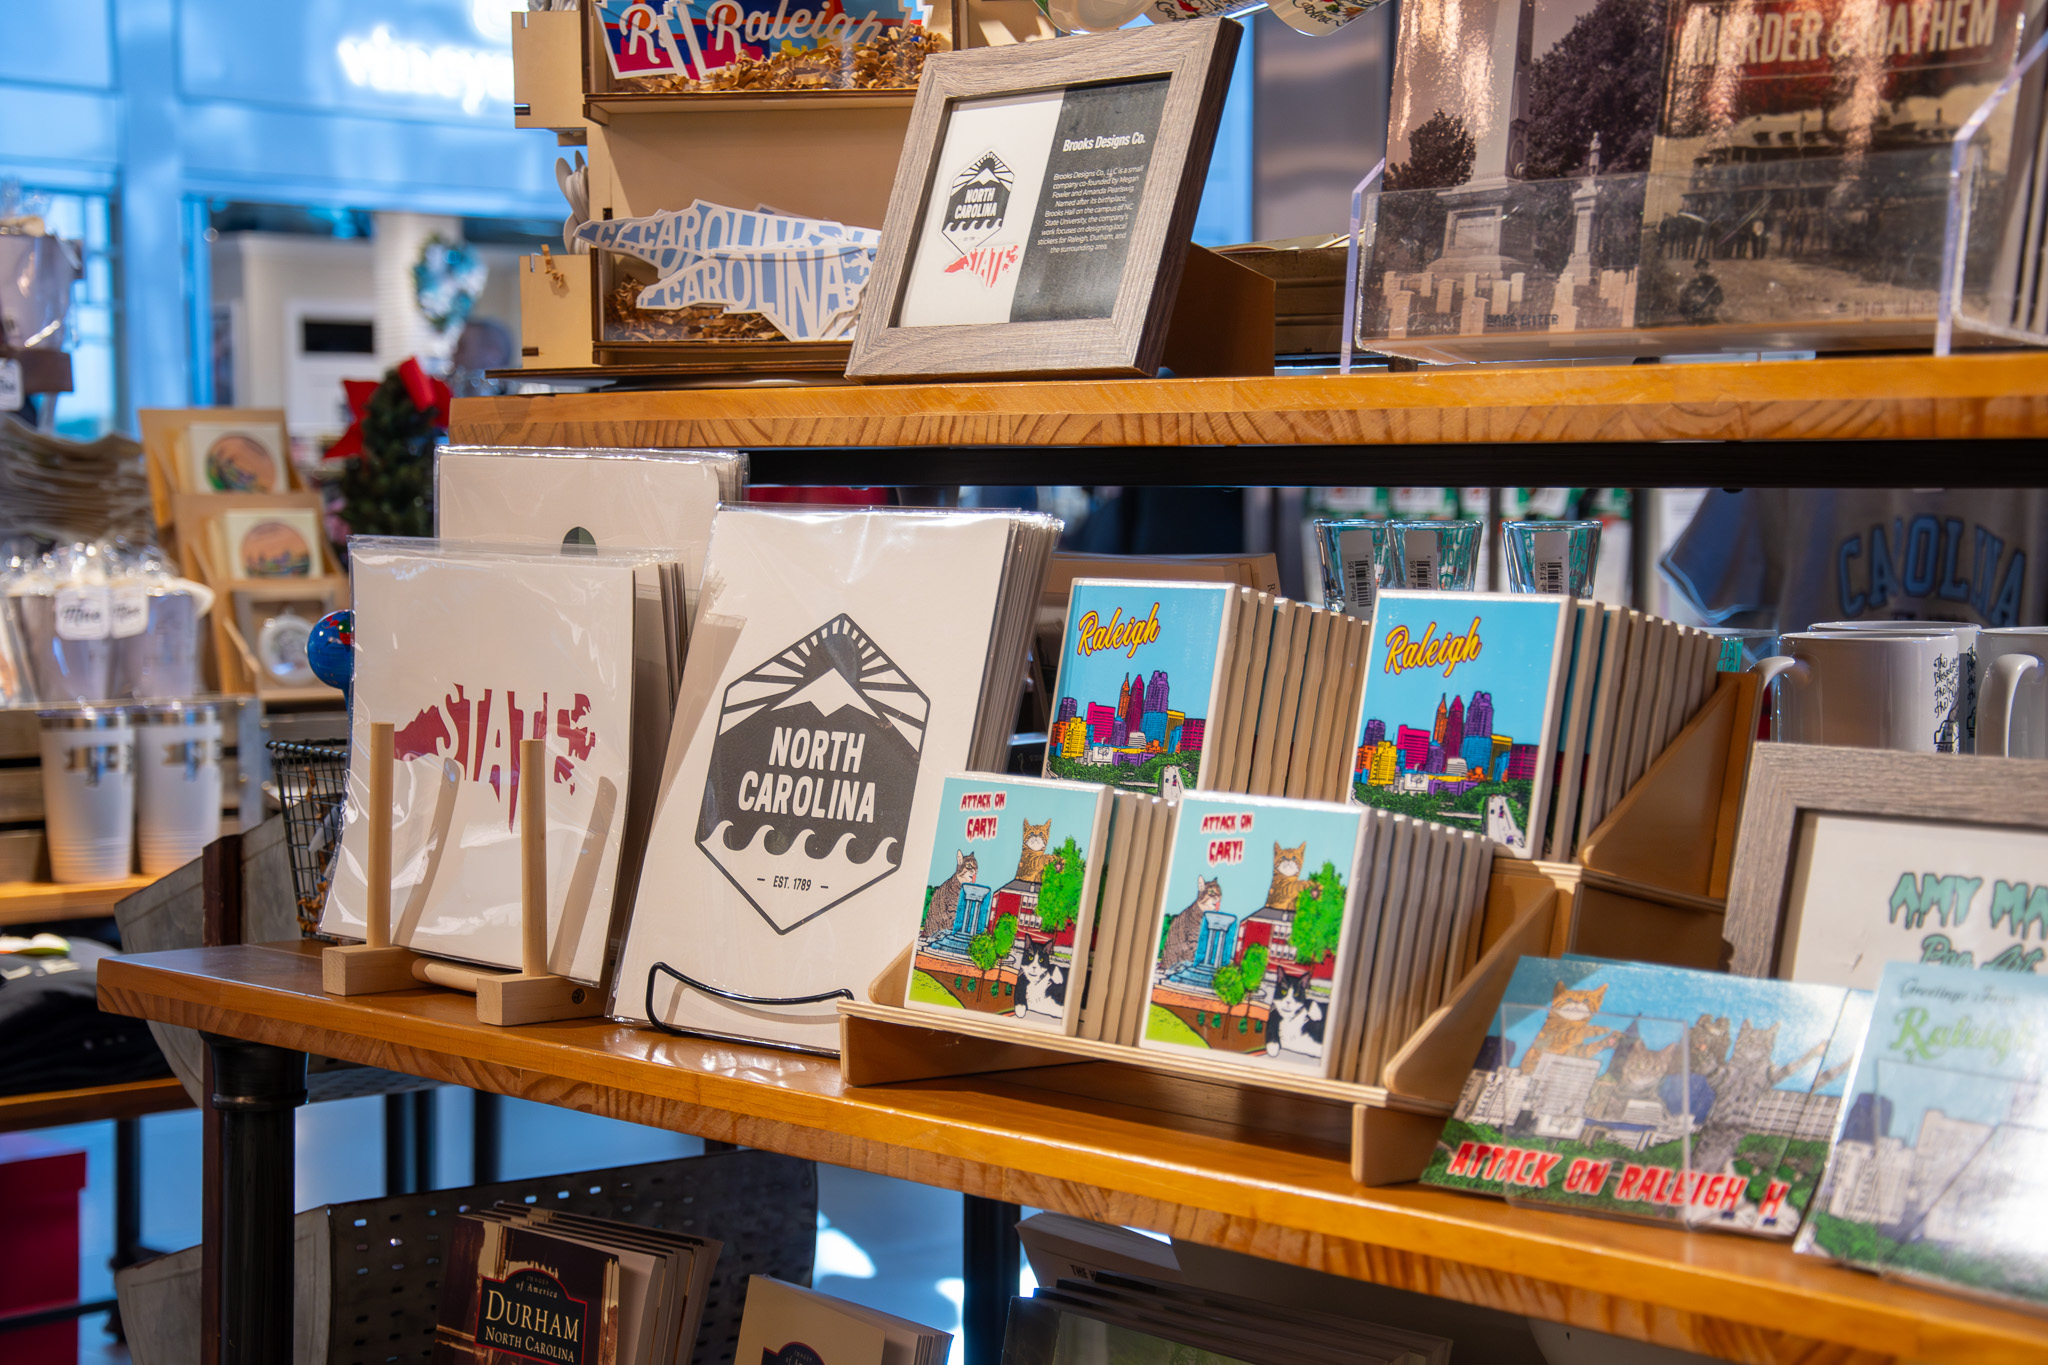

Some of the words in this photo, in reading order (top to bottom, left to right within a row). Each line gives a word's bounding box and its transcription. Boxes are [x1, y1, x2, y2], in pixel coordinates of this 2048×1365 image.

[705, 0, 882, 51] Raleigh
[1063, 138, 1094, 152] Brooks
[1095, 134, 1131, 149] Designs
[1132, 131, 1146, 145] Co.
[1053, 173, 1073, 181] Brooks
[1073, 171, 1095, 180] Designs
[1128, 165, 1145, 174] small
[1052, 181, 1079, 191] company
[1079, 177, 1111, 188] co-founded
[1111, 177, 1119, 186] by
[1119, 176, 1140, 186] Megan
[1052, 191, 1071, 199] Fowler
[1071, 189, 1082, 197] and
[1083, 187, 1107, 196] Amanda
[965, 187, 996, 204] NORTH
[1055, 199, 1076, 207] Named
[1076, 197, 1089, 206] after
[1089, 197, 1098, 205] its
[954, 202, 998, 220] CAROLINA
[1044, 209, 1064, 218] Brooks
[1064, 207, 1076, 216] Hall
[1084, 206, 1095, 215] the
[1094, 205, 1117, 215] campus
[1125, 203, 1135, 212] NC
[1041, 228, 1056, 236] work
[1055, 226, 1077, 235] focuses
[1076, 226, 1085, 234] on
[1085, 223, 1114, 234] designing
[1113, 222, 1128, 231] local
[1044, 219, 1060, 227] State
[1088, 215, 1098, 224] the
[1037, 237, 1059, 246] stickers
[1058, 236, 1068, 244] for
[1114, 232, 1127, 240] and
[1050, 246, 1061, 254] the
[1060, 243, 1095, 253] surrounding
[663, 249, 845, 337] CAROLINA
[1347, 560, 1356, 580] $7.95
[1077, 602, 1161, 659] Raleigh
[1384, 616, 1482, 678] Raleigh
[769, 726, 866, 774] NORTH
[738, 770, 876, 824] CAROLINA
[960, 793, 992, 811] ATTACK
[994, 792, 1006, 809] ON
[966, 816, 998, 841] CARY!
[1201, 815, 1237, 832] ATTACK
[1240, 813, 1253, 831] ON
[1208, 839, 1244, 866] CARY!
[773, 875, 790, 890] EST.
[793, 878, 812, 892] 1789
[1889, 873, 1984, 931] AMY
[1448, 1142, 1562, 1188] ATTACK
[1563, 1156, 1611, 1197] ON
[1614, 1164, 1750, 1210] RALEIGH
[515, 1280, 525, 1292] of
[527, 1283, 559, 1300] America
[485, 1289, 579, 1343] DURHAM
[485, 1325, 522, 1349] NORTH
[525, 1335, 575, 1363] CAROLINA
